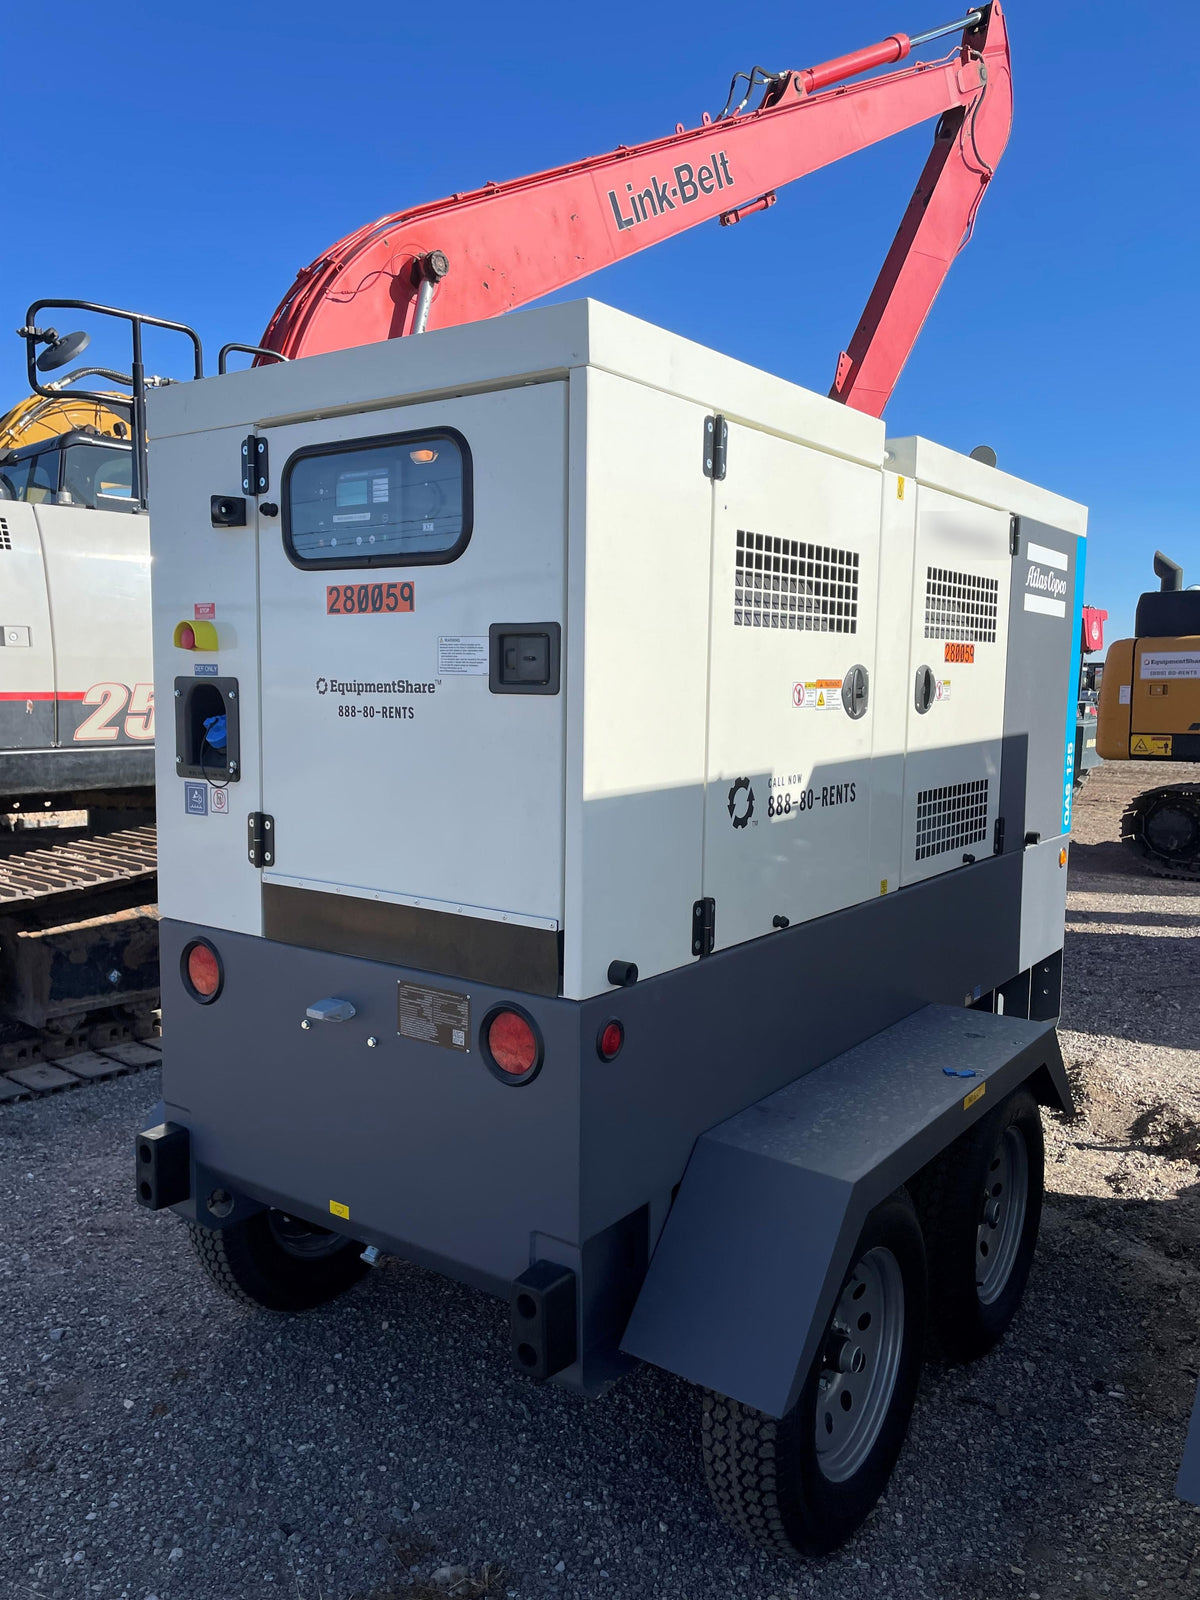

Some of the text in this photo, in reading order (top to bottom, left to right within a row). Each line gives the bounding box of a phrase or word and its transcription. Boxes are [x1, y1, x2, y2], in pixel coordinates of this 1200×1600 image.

[608, 150, 734, 231] Link-Belt
[1025, 565, 1067, 598] Atlas Copco
[328, 582, 415, 614] 280059
[944, 643, 975, 663] 280059
[204, 665, 218, 673] ONLY
[330, 679, 436, 696] EquipmentShare
[338, 705, 415, 719] 888-80-RENTS
[1066, 742, 1074, 777] 125
[767, 773, 803, 789] CALL NOW
[767, 782, 857, 818] 888-80-RENTS
